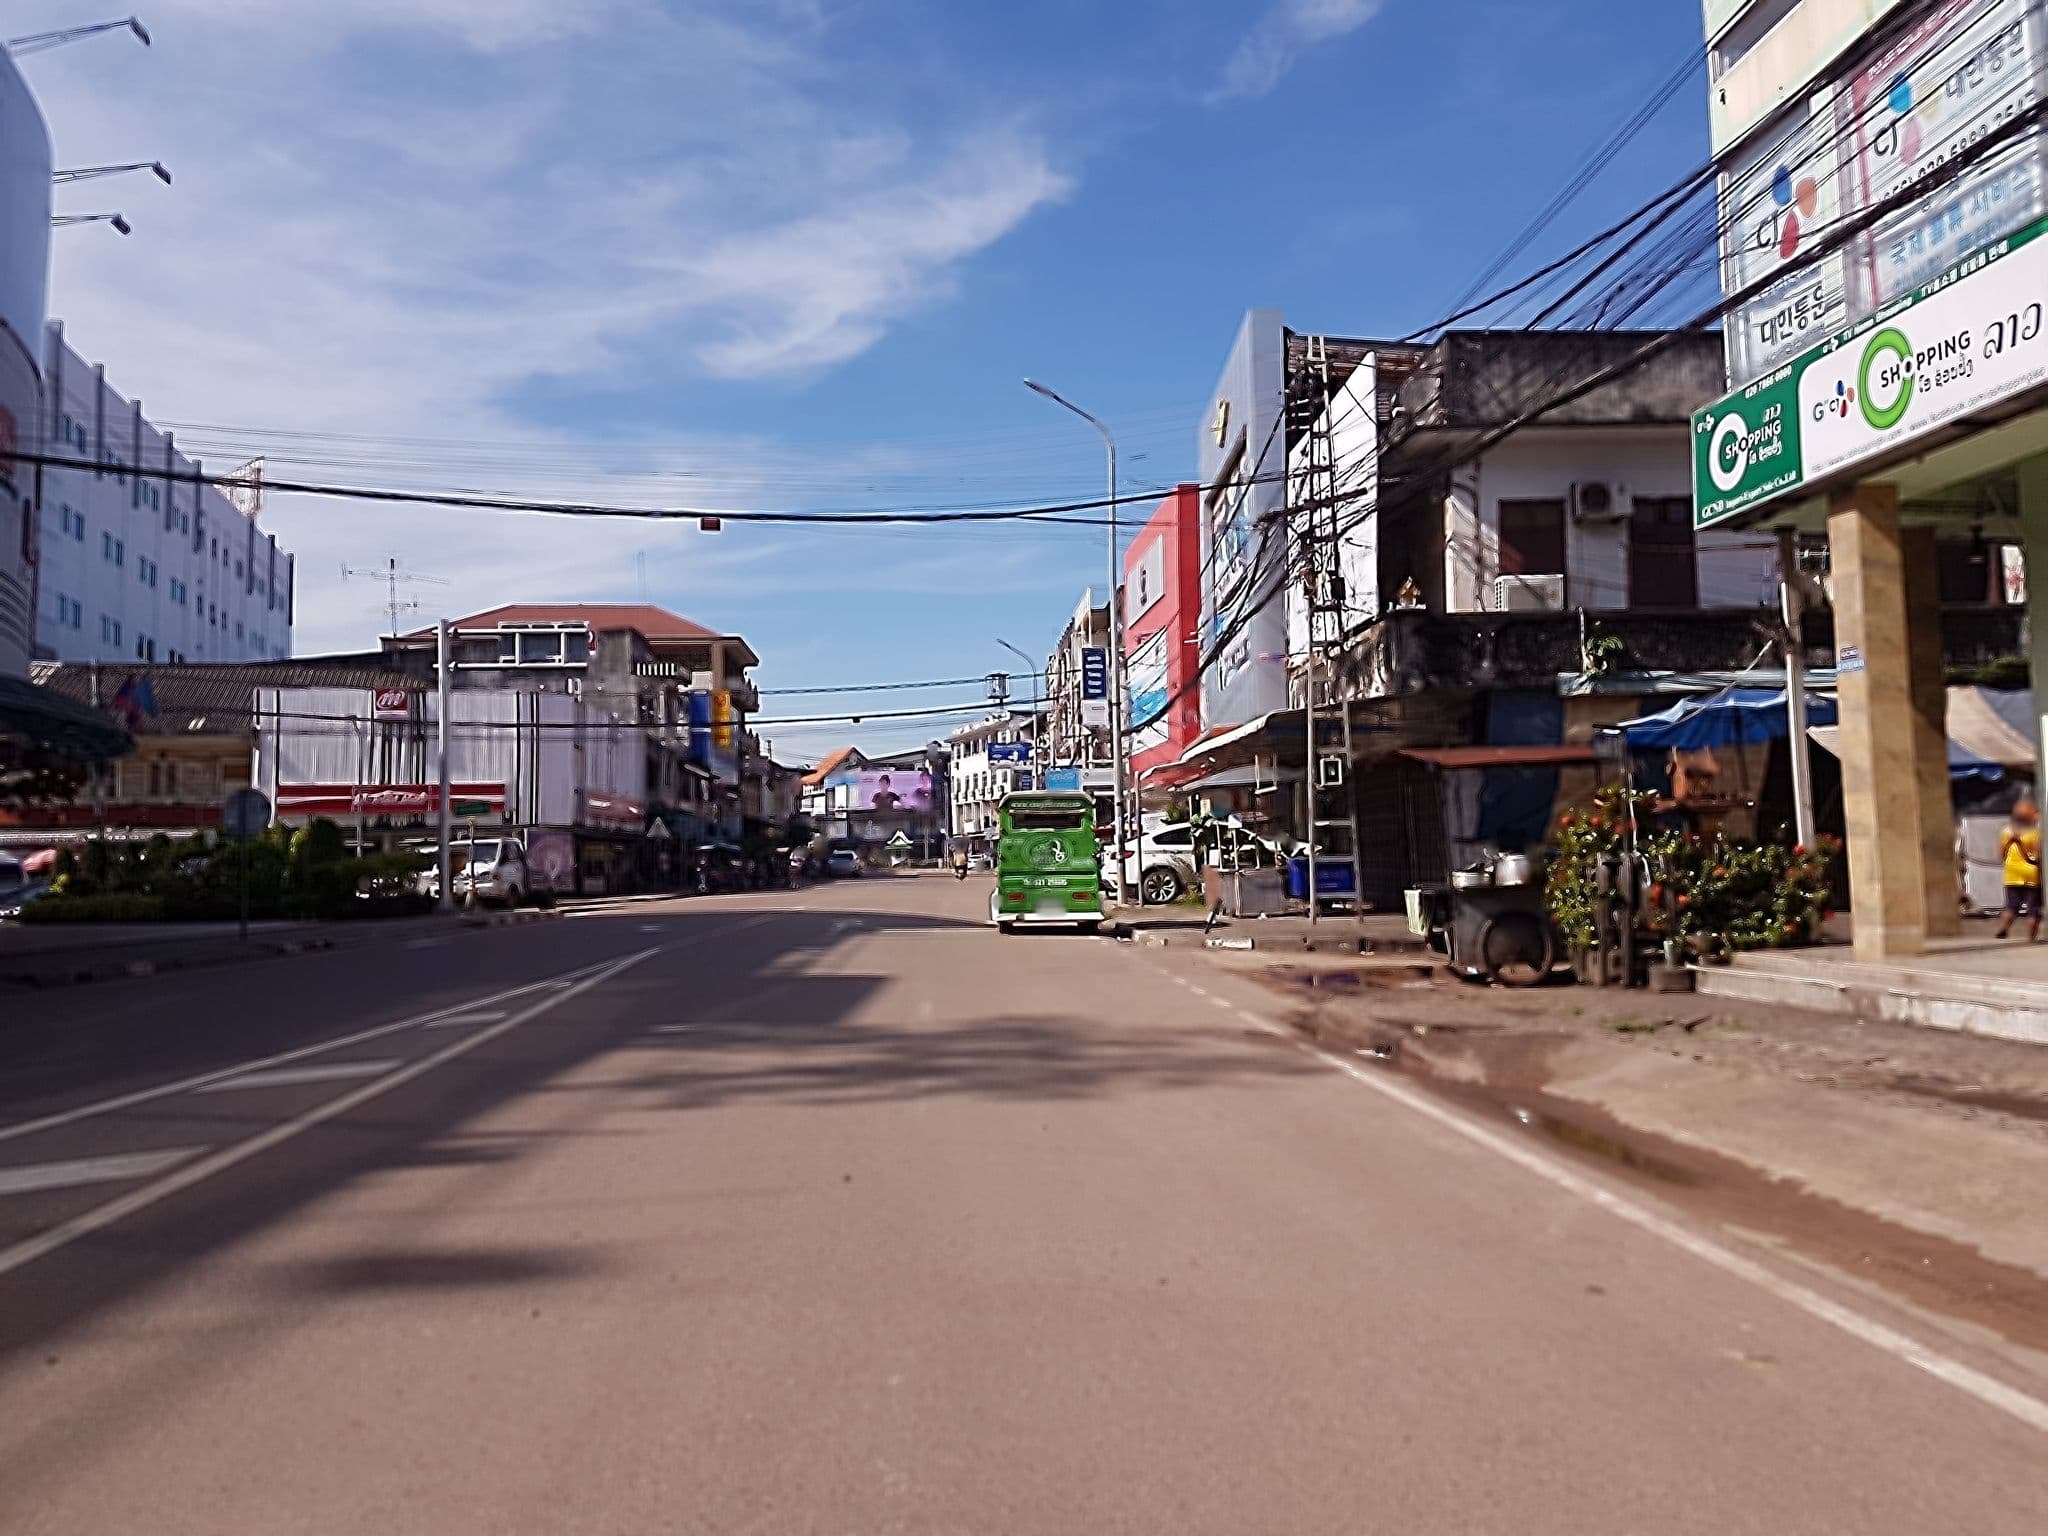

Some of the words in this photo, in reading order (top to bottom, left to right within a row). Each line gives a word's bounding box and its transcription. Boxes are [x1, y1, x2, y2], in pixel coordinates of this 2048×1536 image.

[1757, 209, 1778, 249] CJ
[1982, 302, 2041, 360] ລາວ
[1880, 330, 1971, 388] SHOPPING
[1725, 419, 1782, 460] SHOPPING
